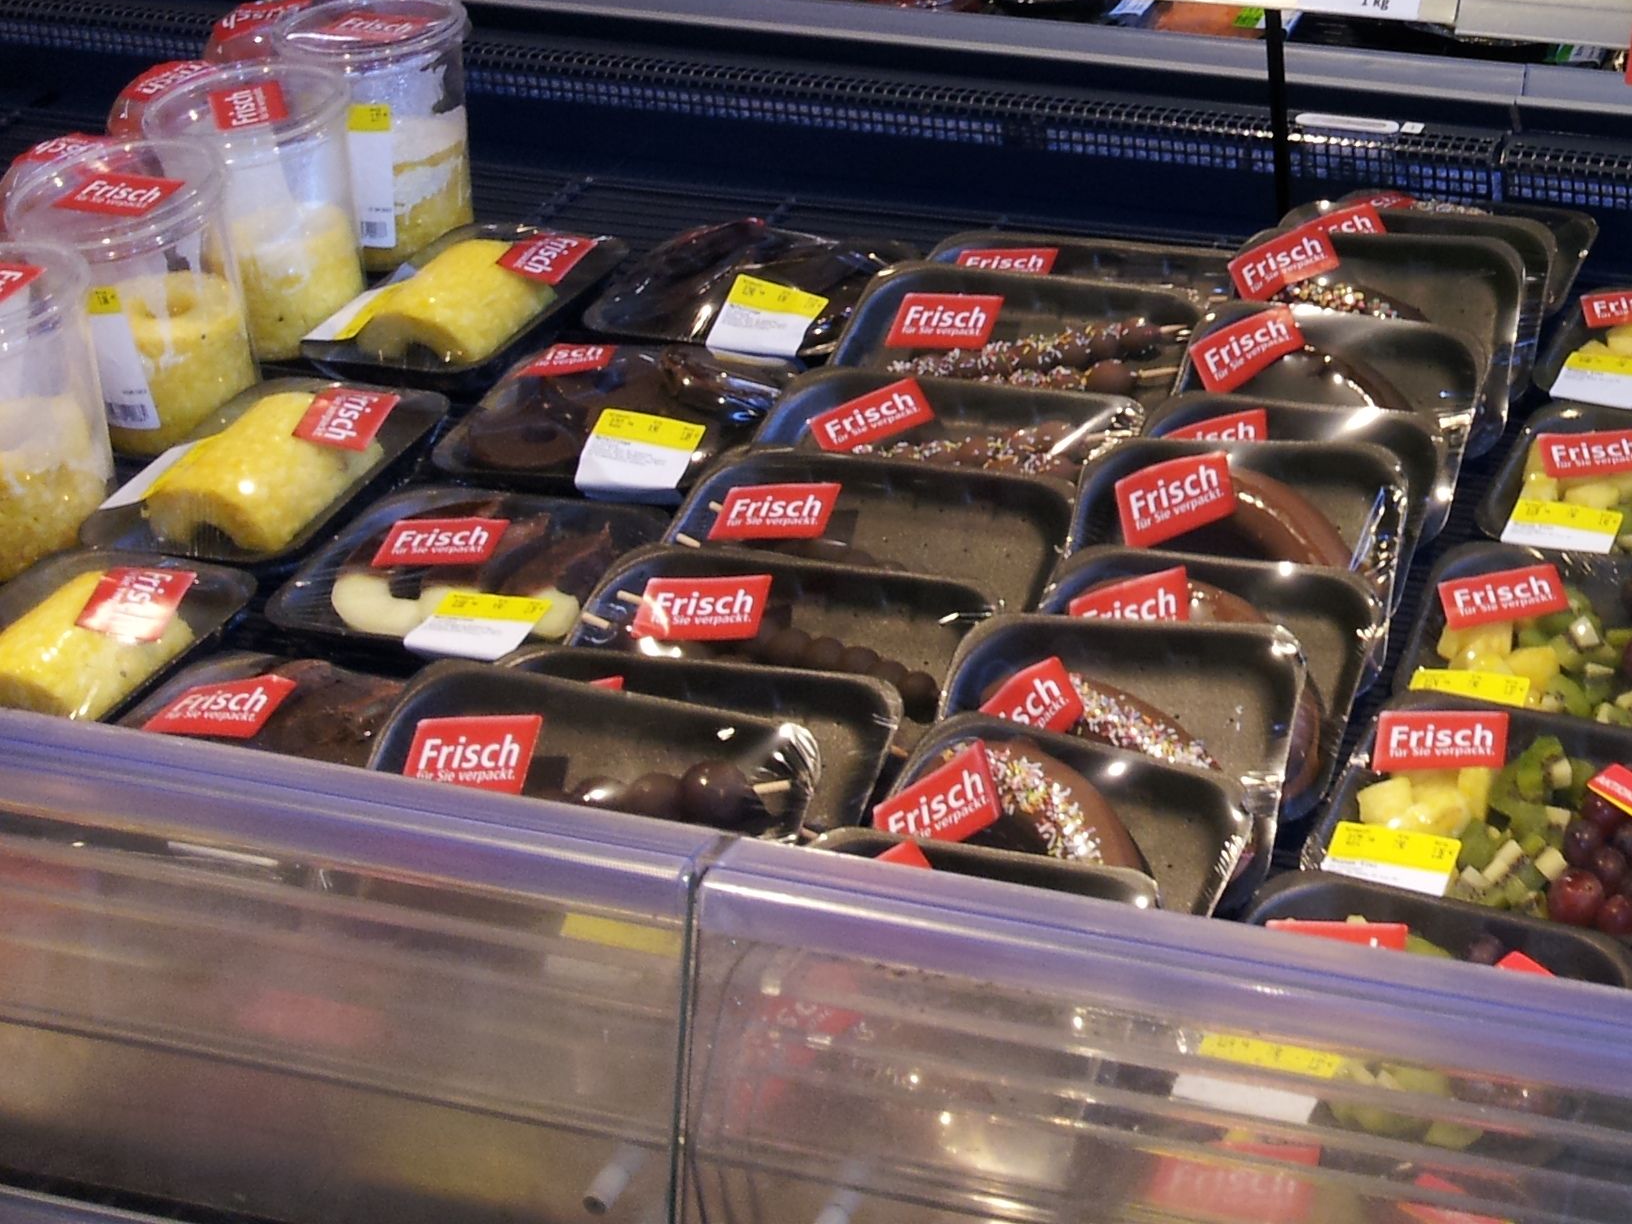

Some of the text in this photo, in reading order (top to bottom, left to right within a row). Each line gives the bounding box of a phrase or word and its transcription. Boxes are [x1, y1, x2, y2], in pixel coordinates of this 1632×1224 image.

[339, 15, 415, 38] Frisch
[229, 89, 250, 127] Frisch
[85, 180, 162, 204] Frisch
[525, 237, 577, 277] Frisch
[1242, 237, 1324, 287] Frisch
[905, 304, 987, 330] Frisch
[1204, 316, 1288, 376] Frisch
[326, 396, 379, 443] Frisch
[824, 389, 915, 440] Frisch
[731, 495, 822, 519] Frisch
[1129, 463, 1220, 520] Frisch
[1135, 488, 1225, 531] für Sie verpackt.
[396, 526, 489, 549] Frisch
[656, 588, 754, 617] Frisch
[1454, 577, 1551, 607] Frisch
[176, 688, 268, 713] Frisch
[418, 734, 520, 771] Frisch
[1389, 747, 1409, 758] für
[1411, 747, 1432, 758] Sie
[1390, 724, 1494, 749] Frisch
[888, 769, 985, 835] Frisch
